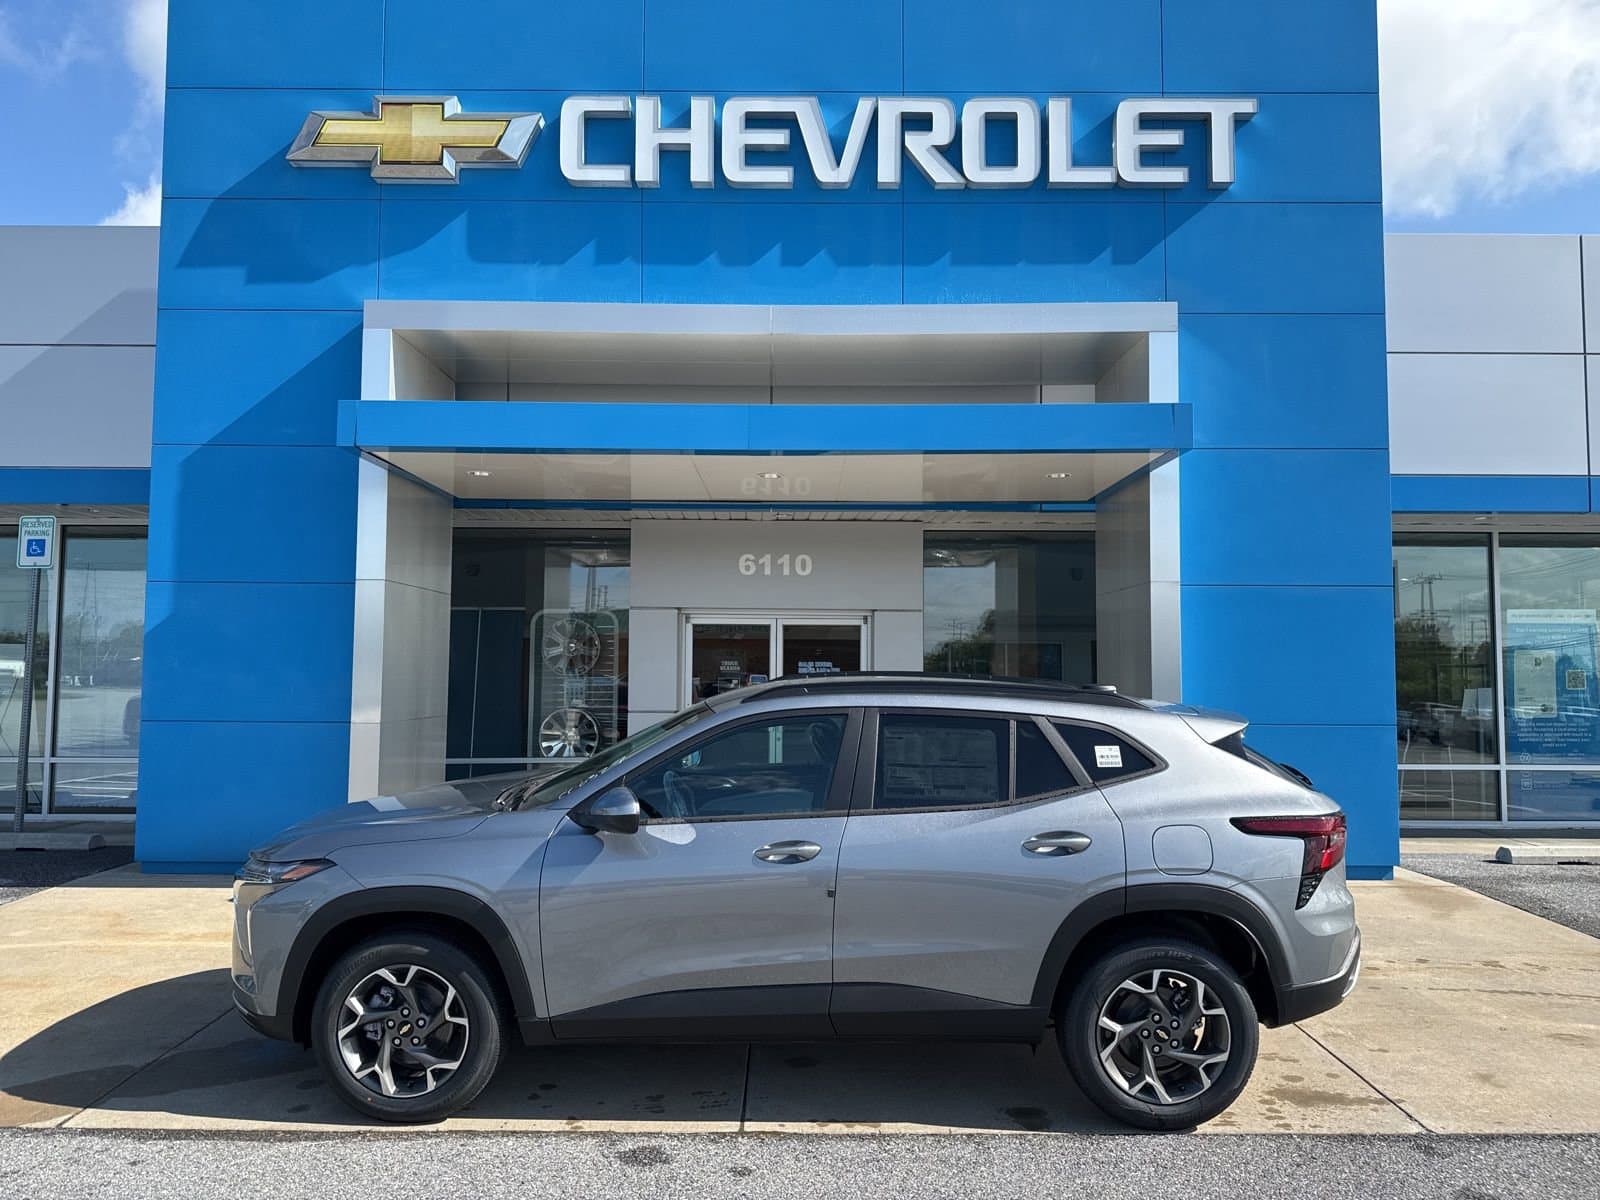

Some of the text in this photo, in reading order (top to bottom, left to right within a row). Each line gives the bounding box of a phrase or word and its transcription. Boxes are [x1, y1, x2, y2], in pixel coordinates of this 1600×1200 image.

[559, 96, 1257, 189] CHEVROLET
[23, 529, 50, 537] PARKING
[738, 553, 813, 576] 6110
